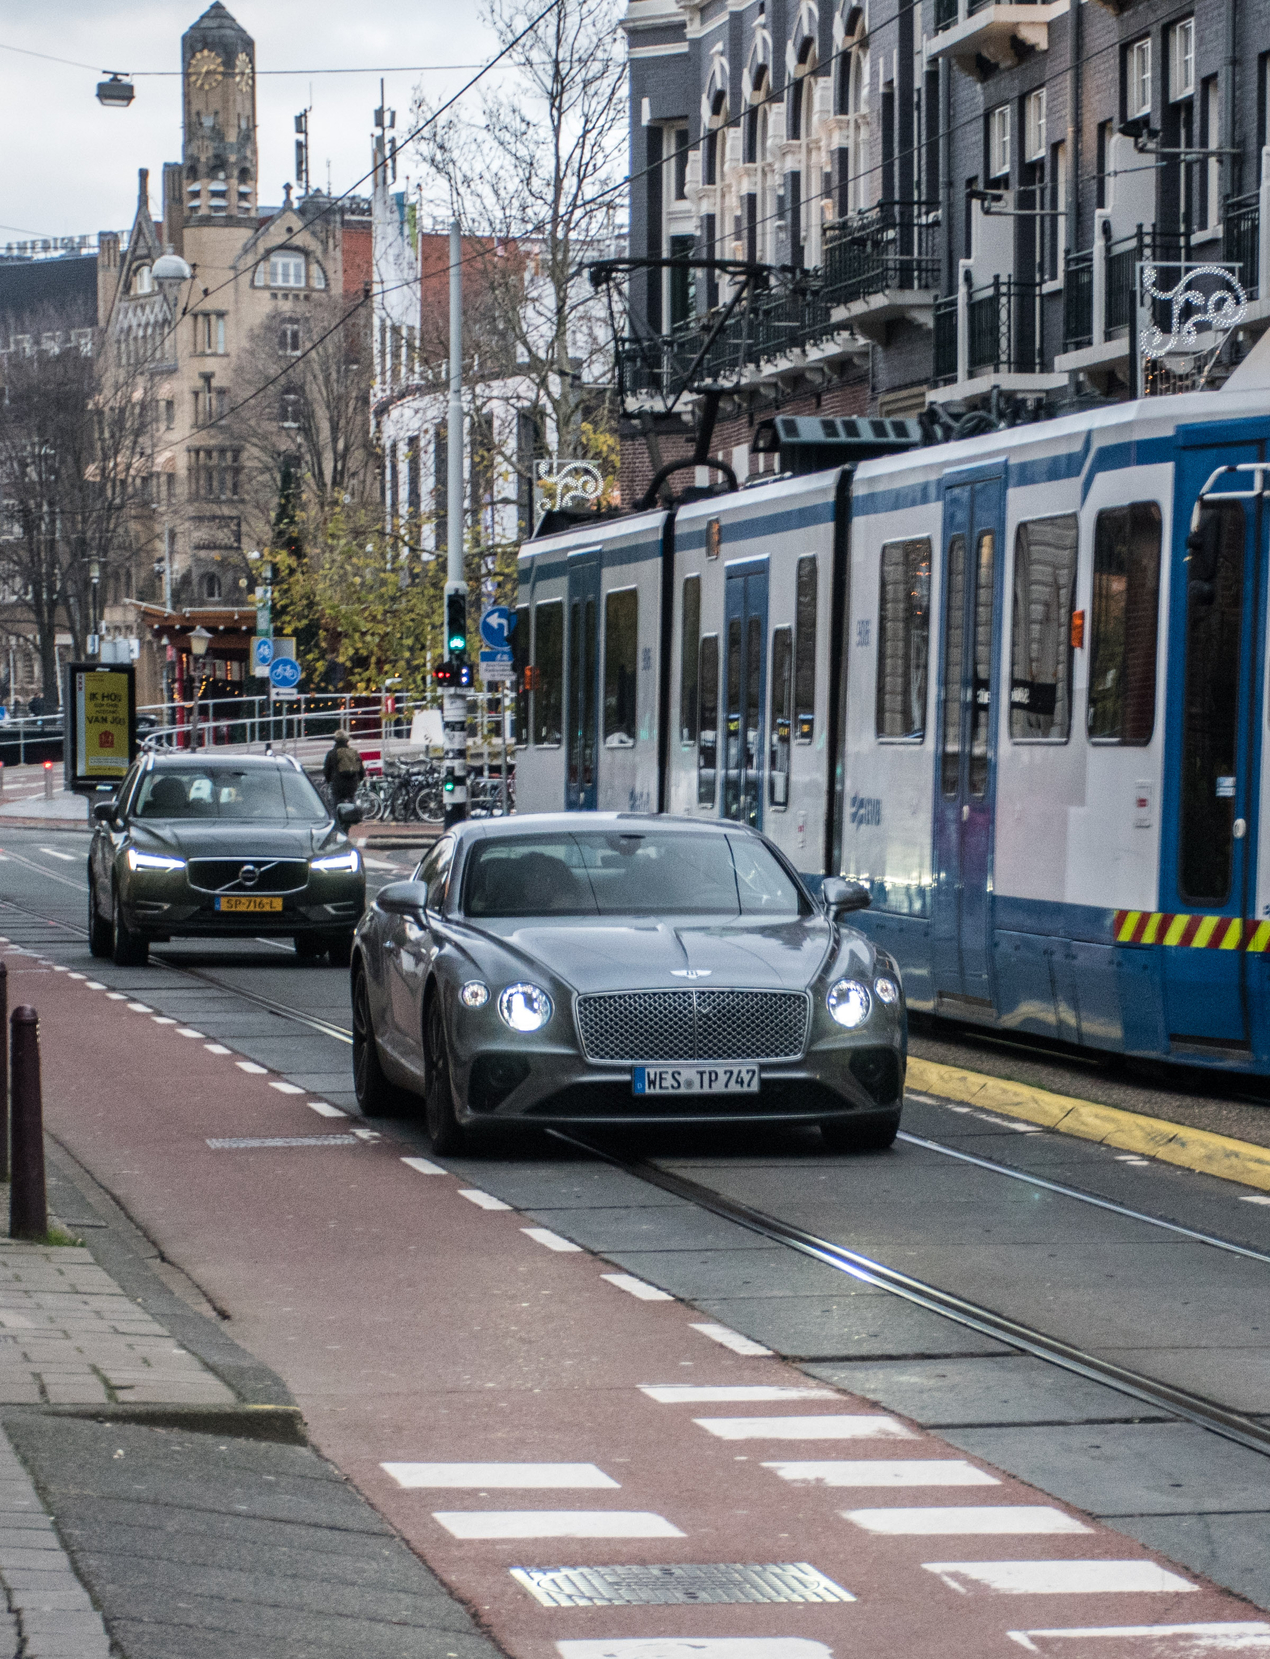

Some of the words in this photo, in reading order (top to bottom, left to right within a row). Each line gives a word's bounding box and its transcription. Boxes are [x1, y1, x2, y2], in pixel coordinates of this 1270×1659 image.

[86, 716, 108, 724] VAN
[226, 898, 276, 909] SP-716-L
[646, 1070, 682, 1090] WES
[696, 1070, 718, 1090] TP
[724, 1069, 756, 1089] 747
